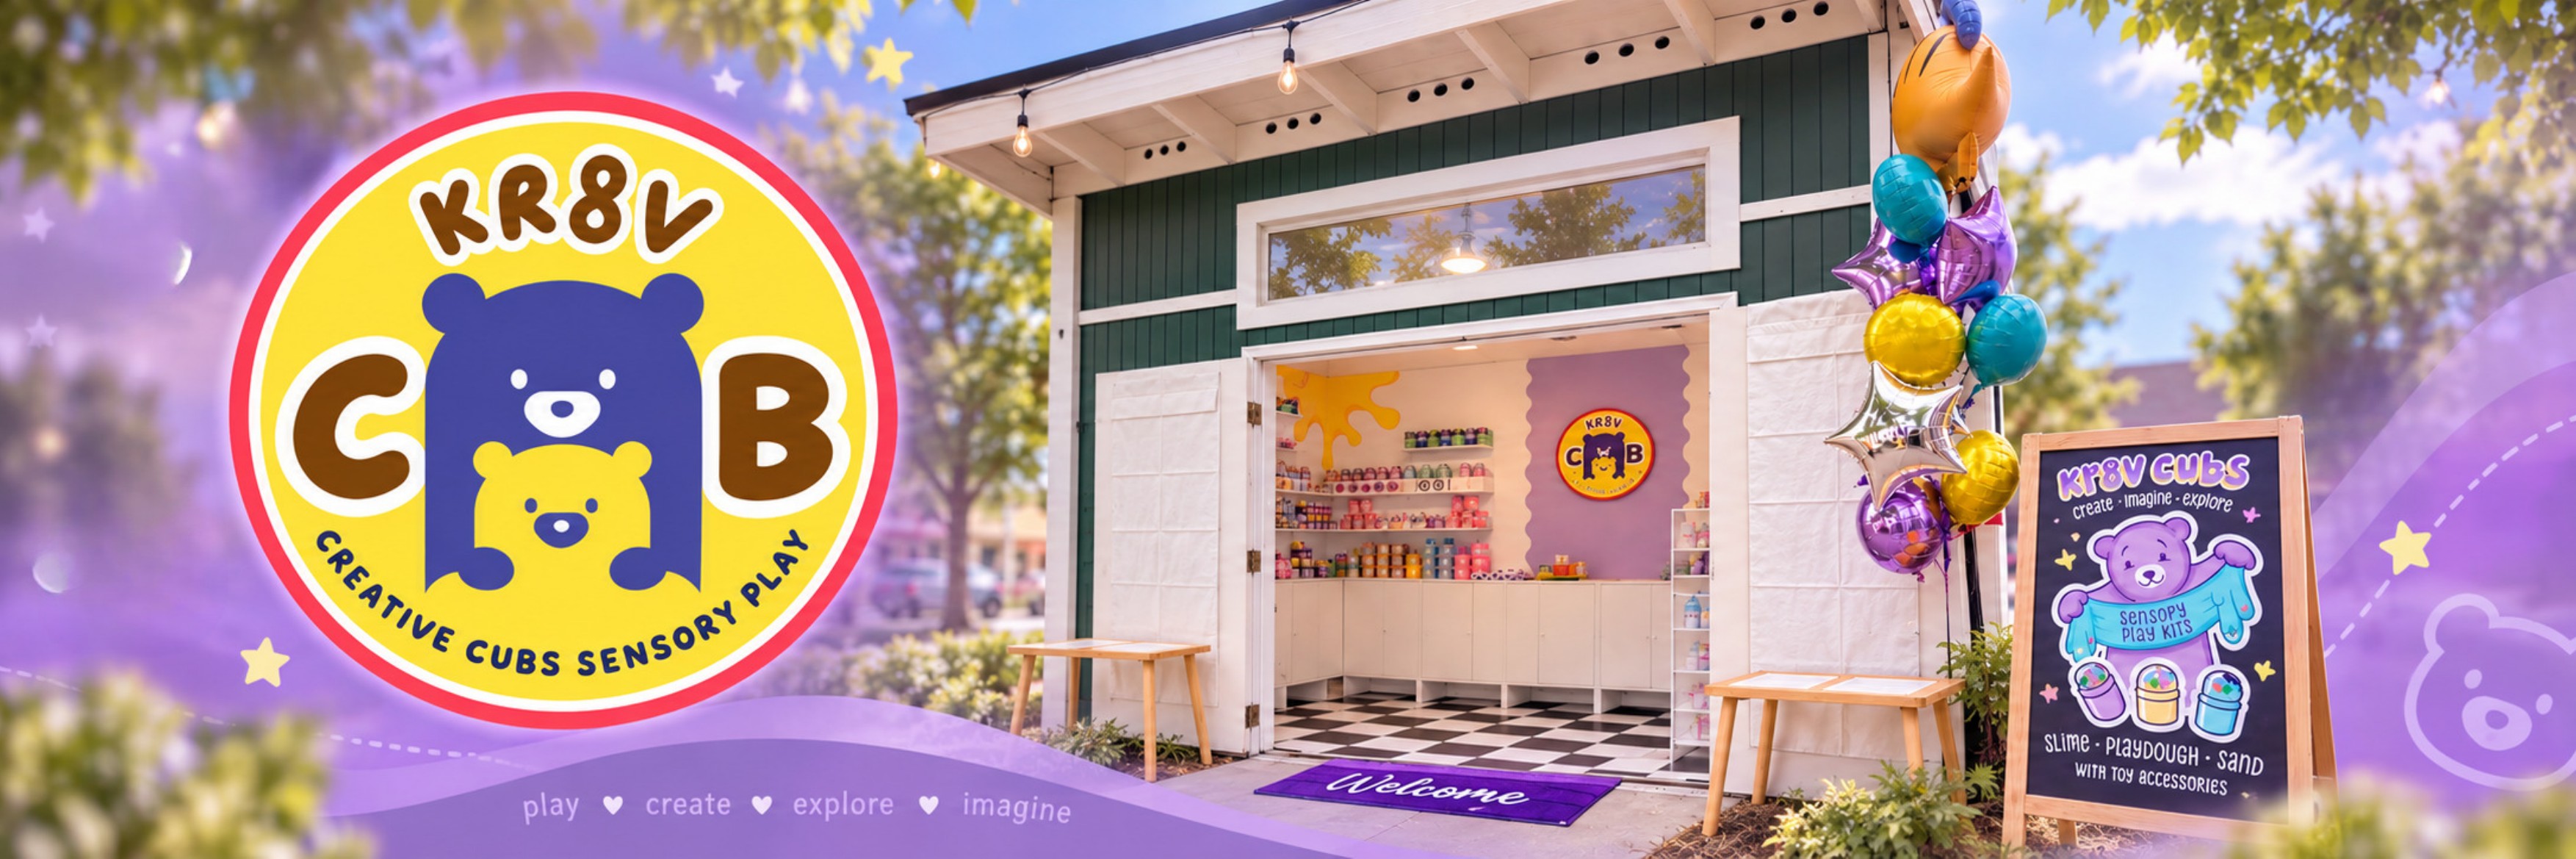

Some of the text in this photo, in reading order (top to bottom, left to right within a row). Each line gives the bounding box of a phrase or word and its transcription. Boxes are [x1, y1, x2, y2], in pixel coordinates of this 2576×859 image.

[1585, 416, 1622, 430] KR8V
[2073, 497, 2113, 520] create
[2182, 493, 2234, 512] explore
[1326, 772, 1530, 805] Welcome
